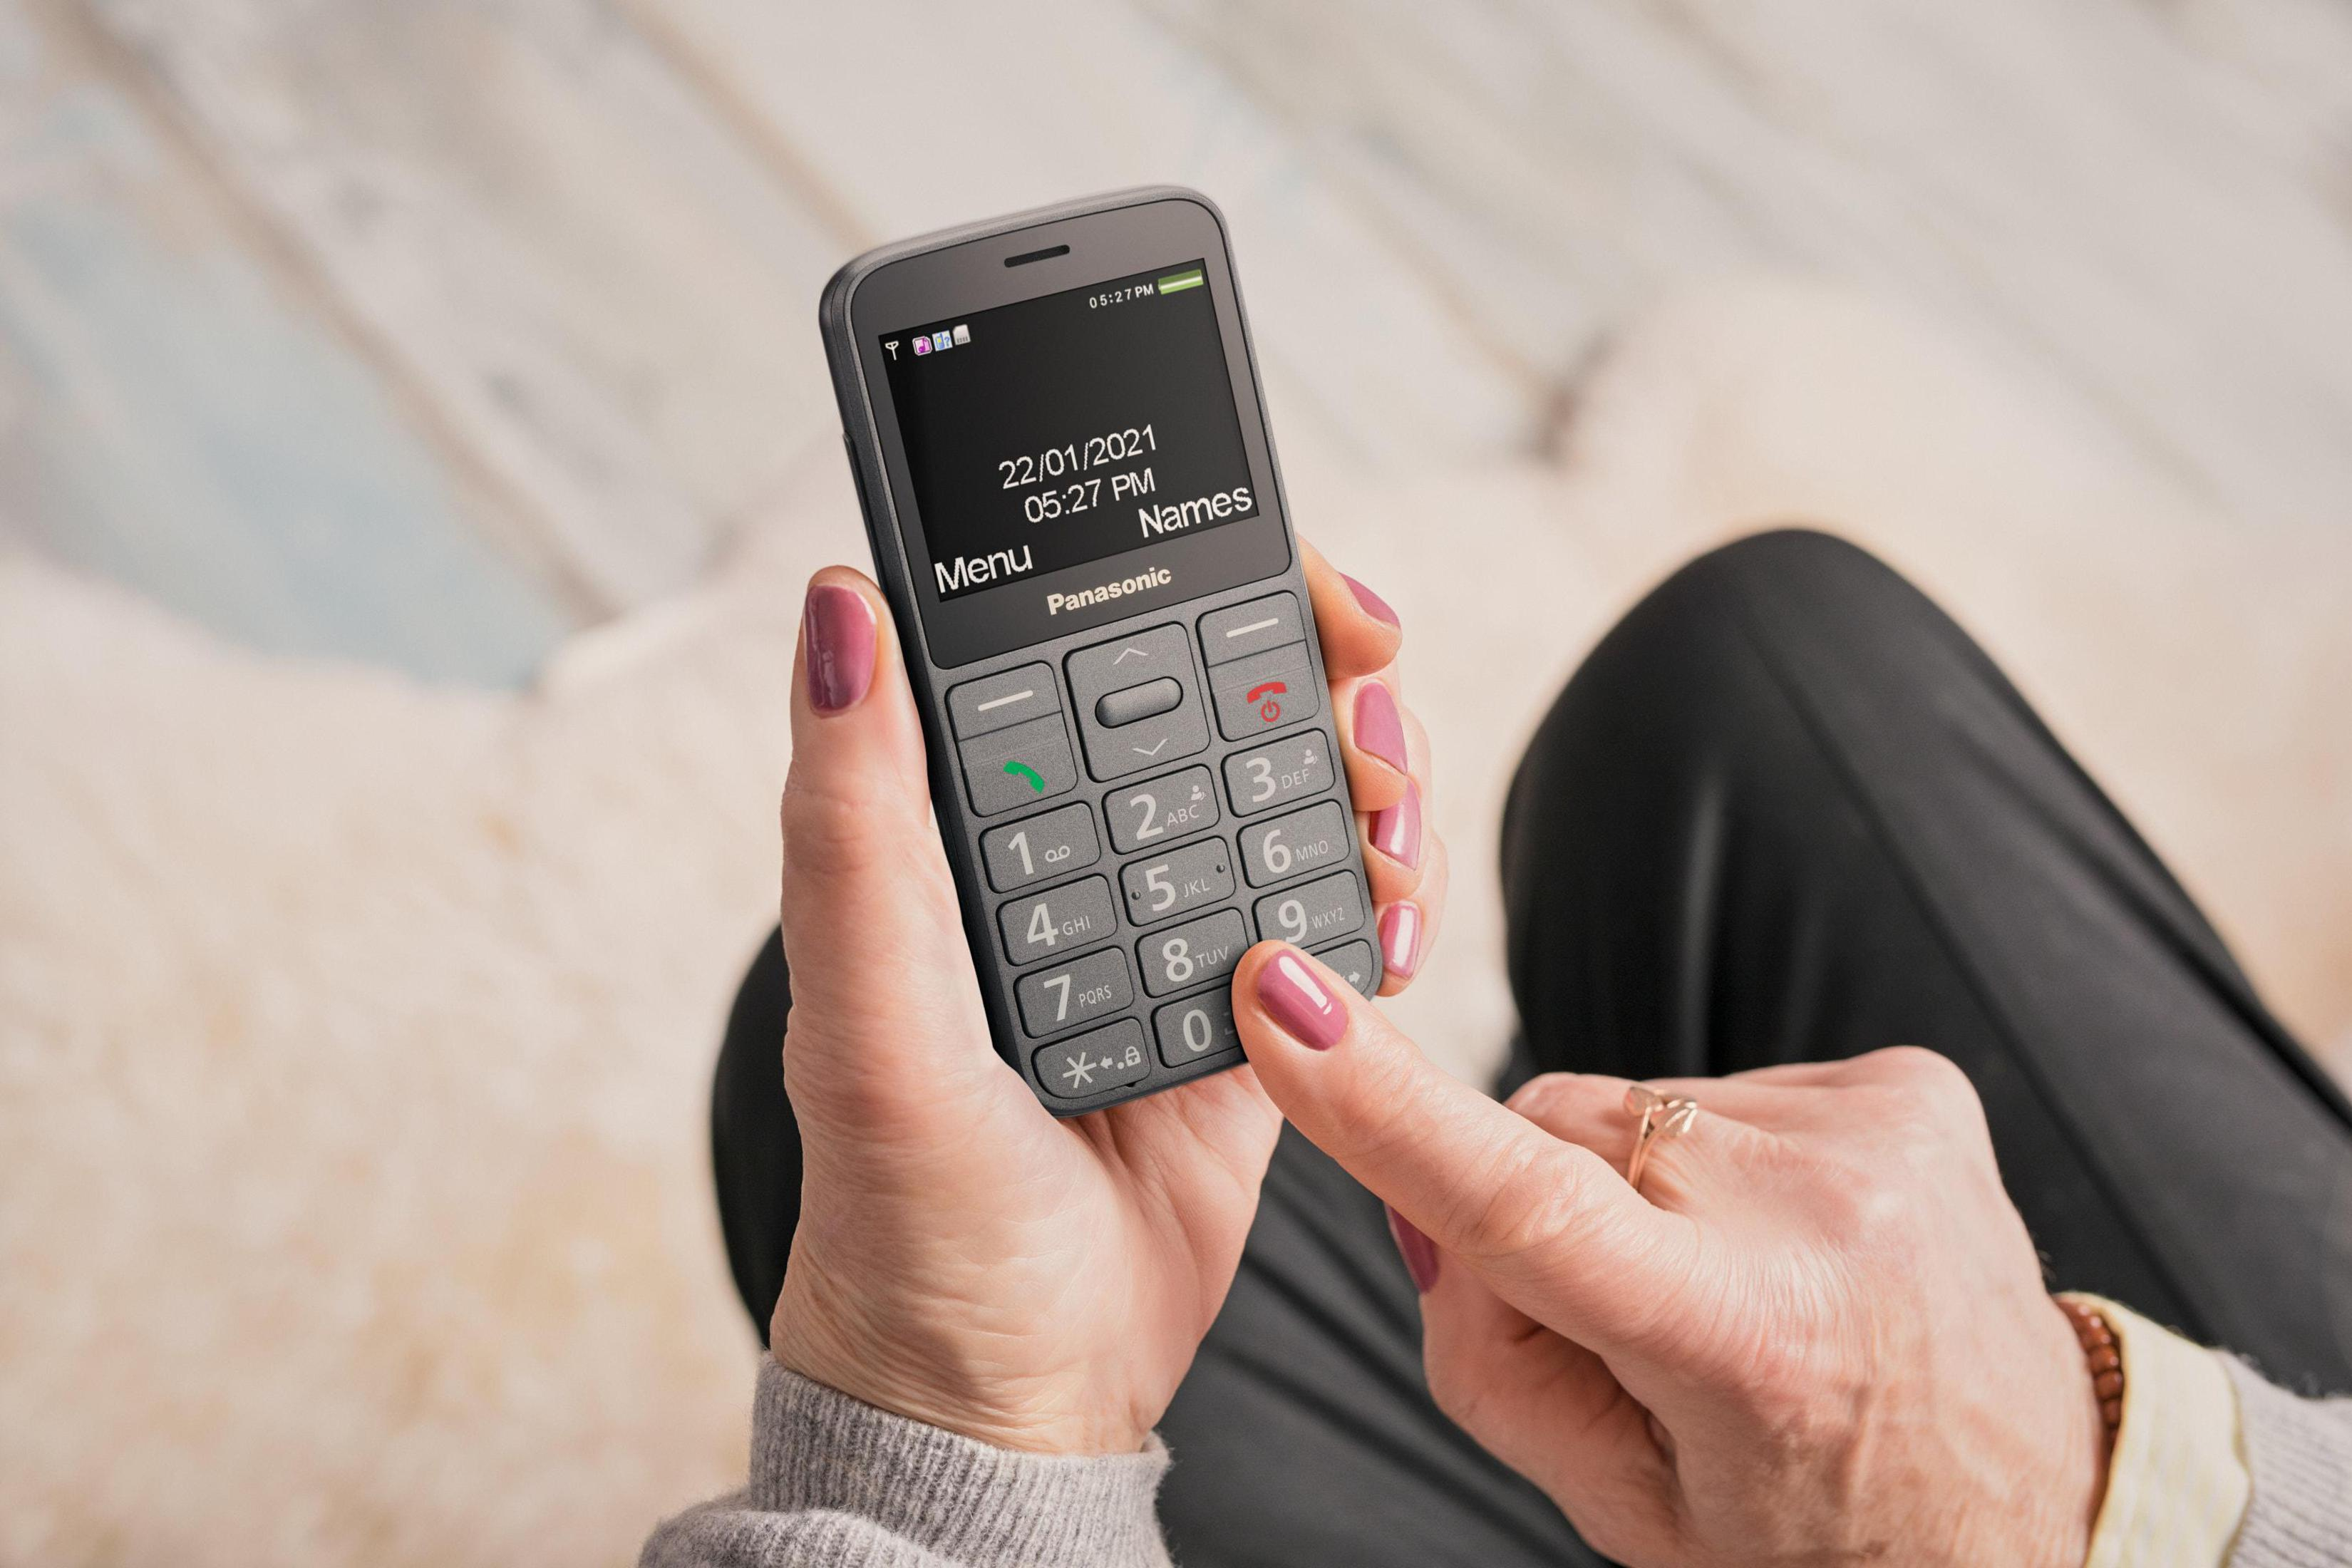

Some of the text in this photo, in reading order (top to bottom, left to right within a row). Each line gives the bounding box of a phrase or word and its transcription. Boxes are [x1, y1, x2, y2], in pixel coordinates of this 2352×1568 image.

[999, 423, 1156, 490] 22/01/2021
[1024, 467, 1156, 523] 05:27 PM
[1138, 487, 1252, 538] Names
[934, 545, 1033, 594] Menu
[1046, 568, 1172, 615] Panasonic
[1245, 757, 1310, 803] 3 DEF
[1130, 793, 1200, 841] 2 ABC
[1009, 831, 1034, 875] 1
[1262, 829, 1329, 874] 6 MNO
[1145, 864, 1211, 912] 5 JKL
[1026, 902, 1091, 947] 4 GHI
[1277, 899, 1346, 944] 9 WXYZ
[1162, 937, 1229, 982] 8 TUV
[1043, 974, 1112, 1021] 7 PQRS
[1182, 1009, 1212, 1052] 0
